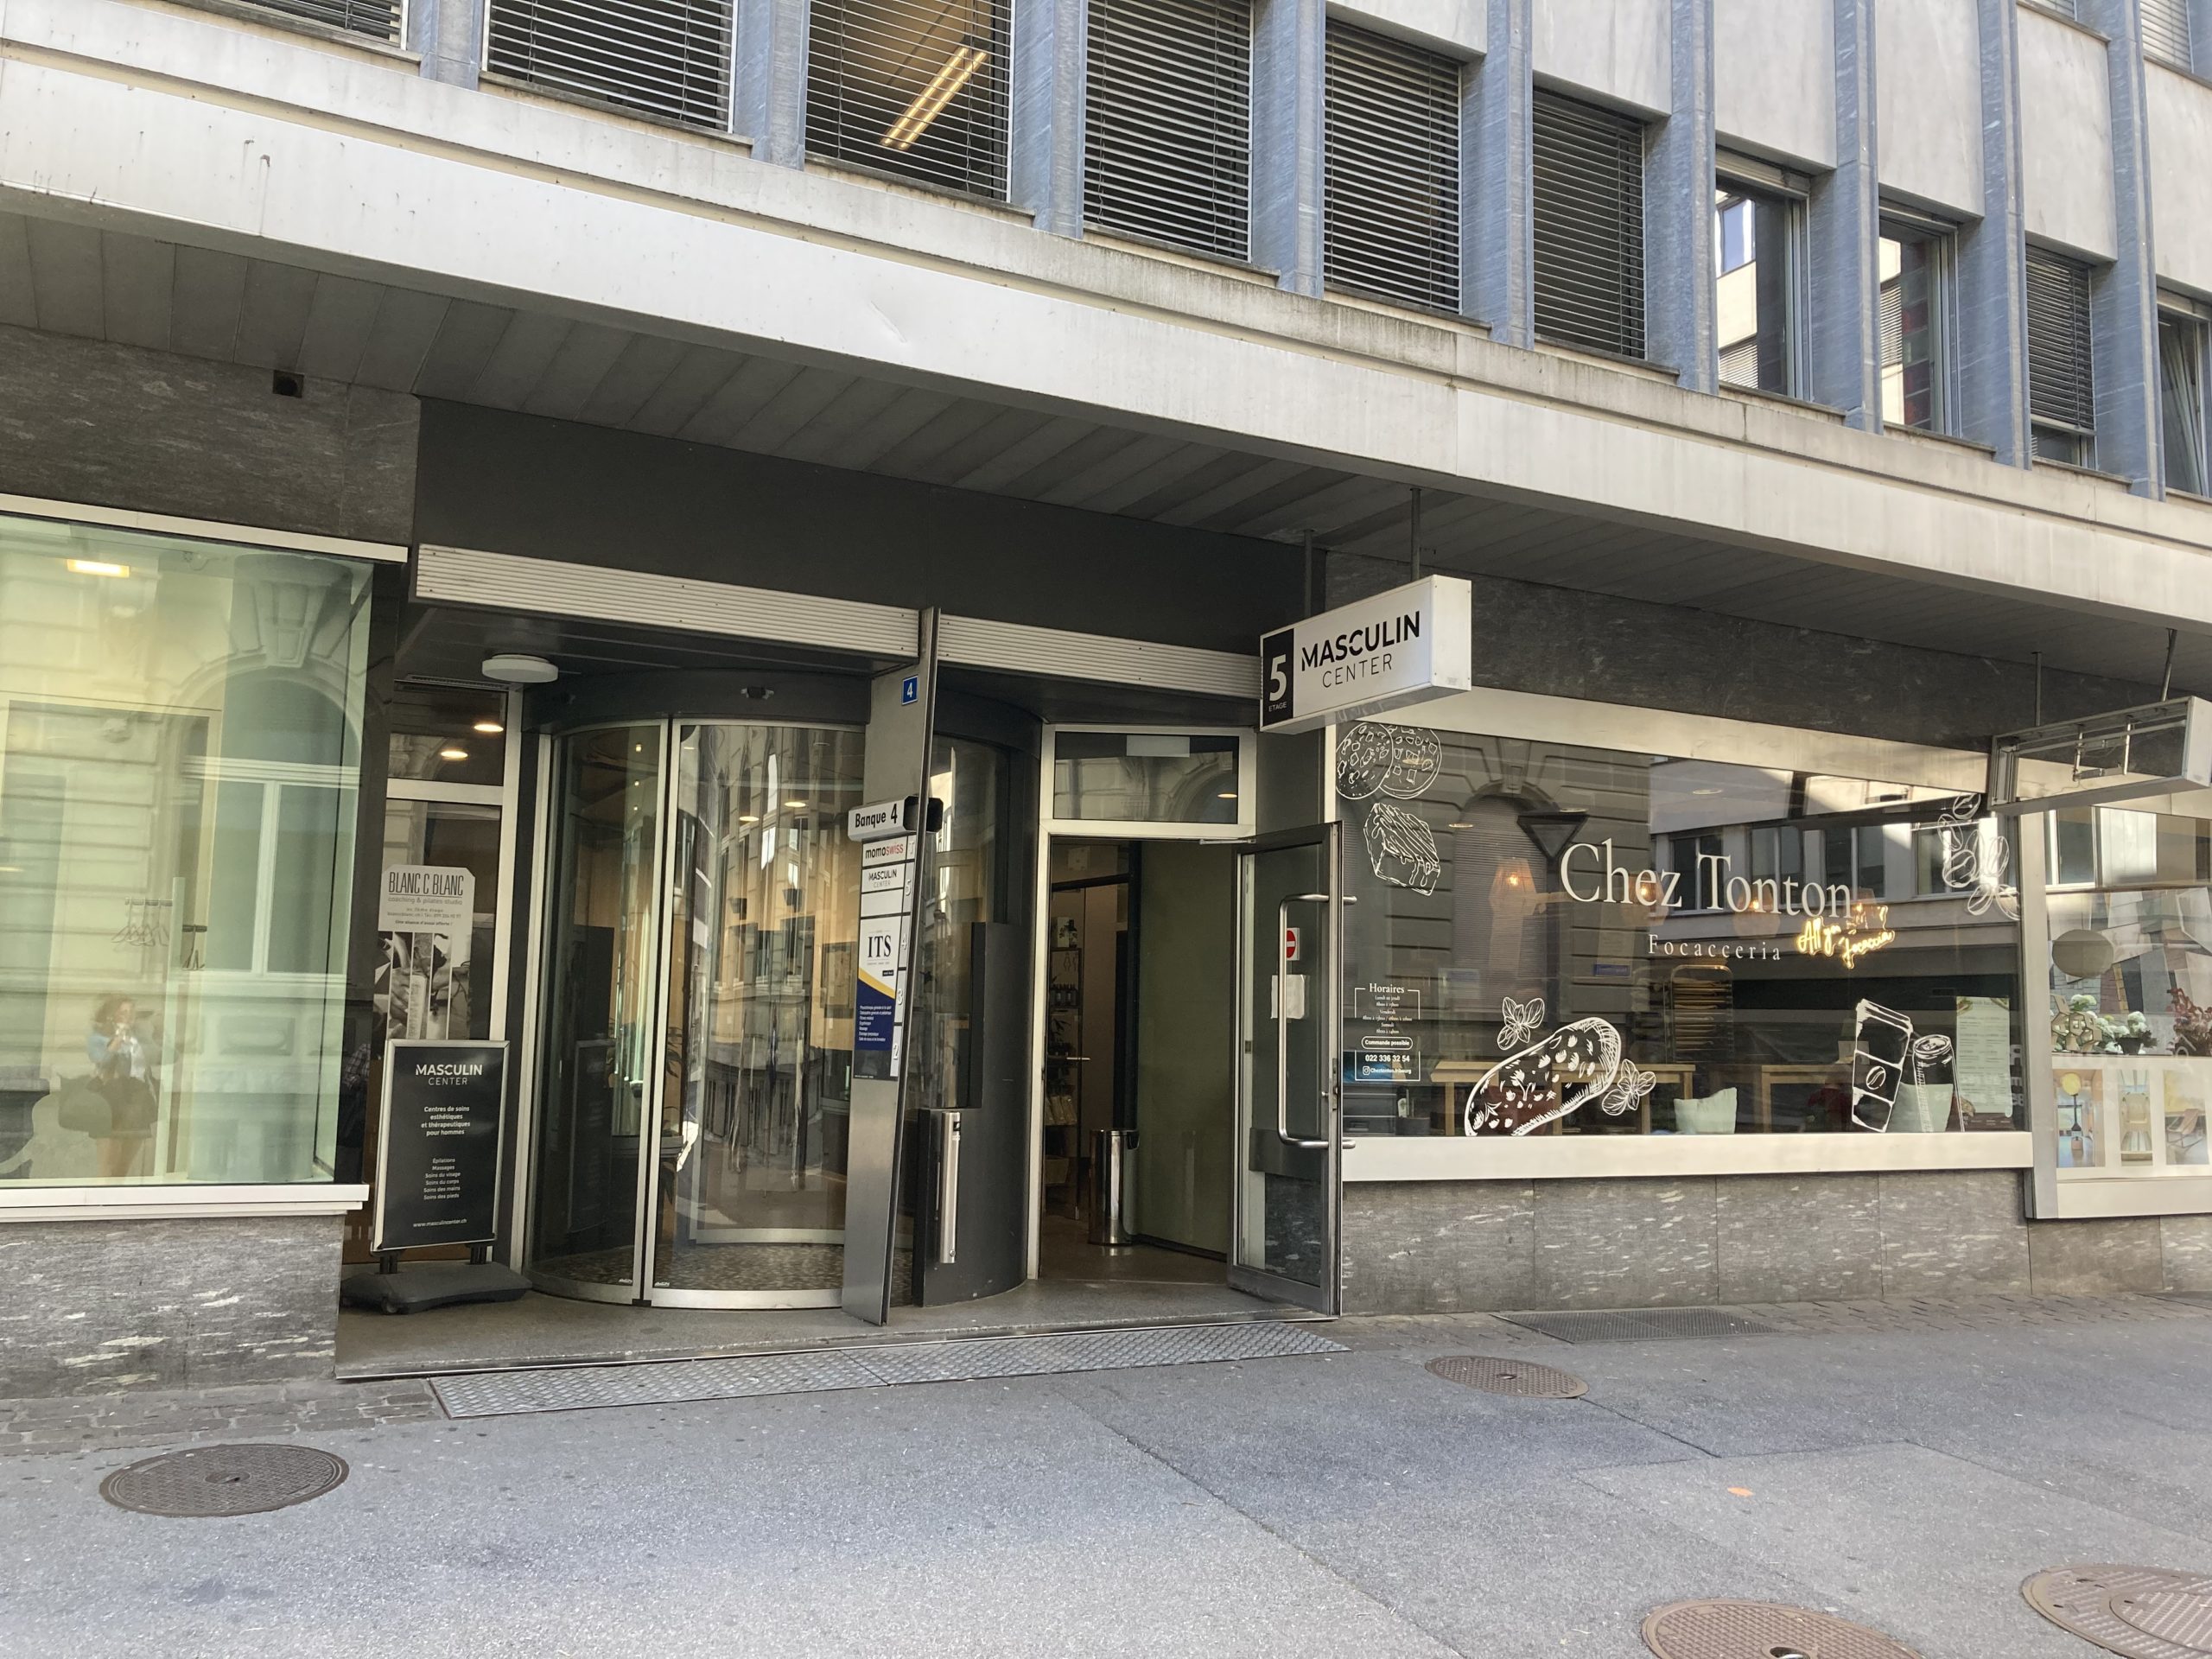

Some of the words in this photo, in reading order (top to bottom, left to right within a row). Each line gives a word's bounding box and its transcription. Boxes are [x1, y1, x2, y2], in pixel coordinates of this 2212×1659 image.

[1301, 610, 1421, 672] MASCULIN
[1268, 653, 1287, 702] 5
[1322, 653, 1393, 688] CENTER
[906, 682, 913, 698] 4
[1268, 702, 1287, 712] ETAGE
[855, 810, 887, 829] Banque
[890, 803, 898, 824] 4
[865, 842, 904, 860] momoswiss
[388, 871, 421, 894] BLANC
[423, 874, 429, 894] C
[433, 874, 464, 896] BLANC
[868, 868, 897, 881] MASCULIN
[1560, 837, 1682, 908] Chez
[1696, 851, 1853, 918] Tonton
[873, 880, 891, 888] CENTER
[868, 934, 892, 958] ITS
[1648, 933, 1782, 962] Focacceria
[897, 988, 904, 1006] 3
[1369, 982, 1405, 994] Horaires
[893, 1043, 899, 1060] 2
[415, 1064, 483, 1076] MASCULIN
[428, 1077, 467, 1086] CENTER
[413, 1218, 467, 1227] www.masculincenter.ch
